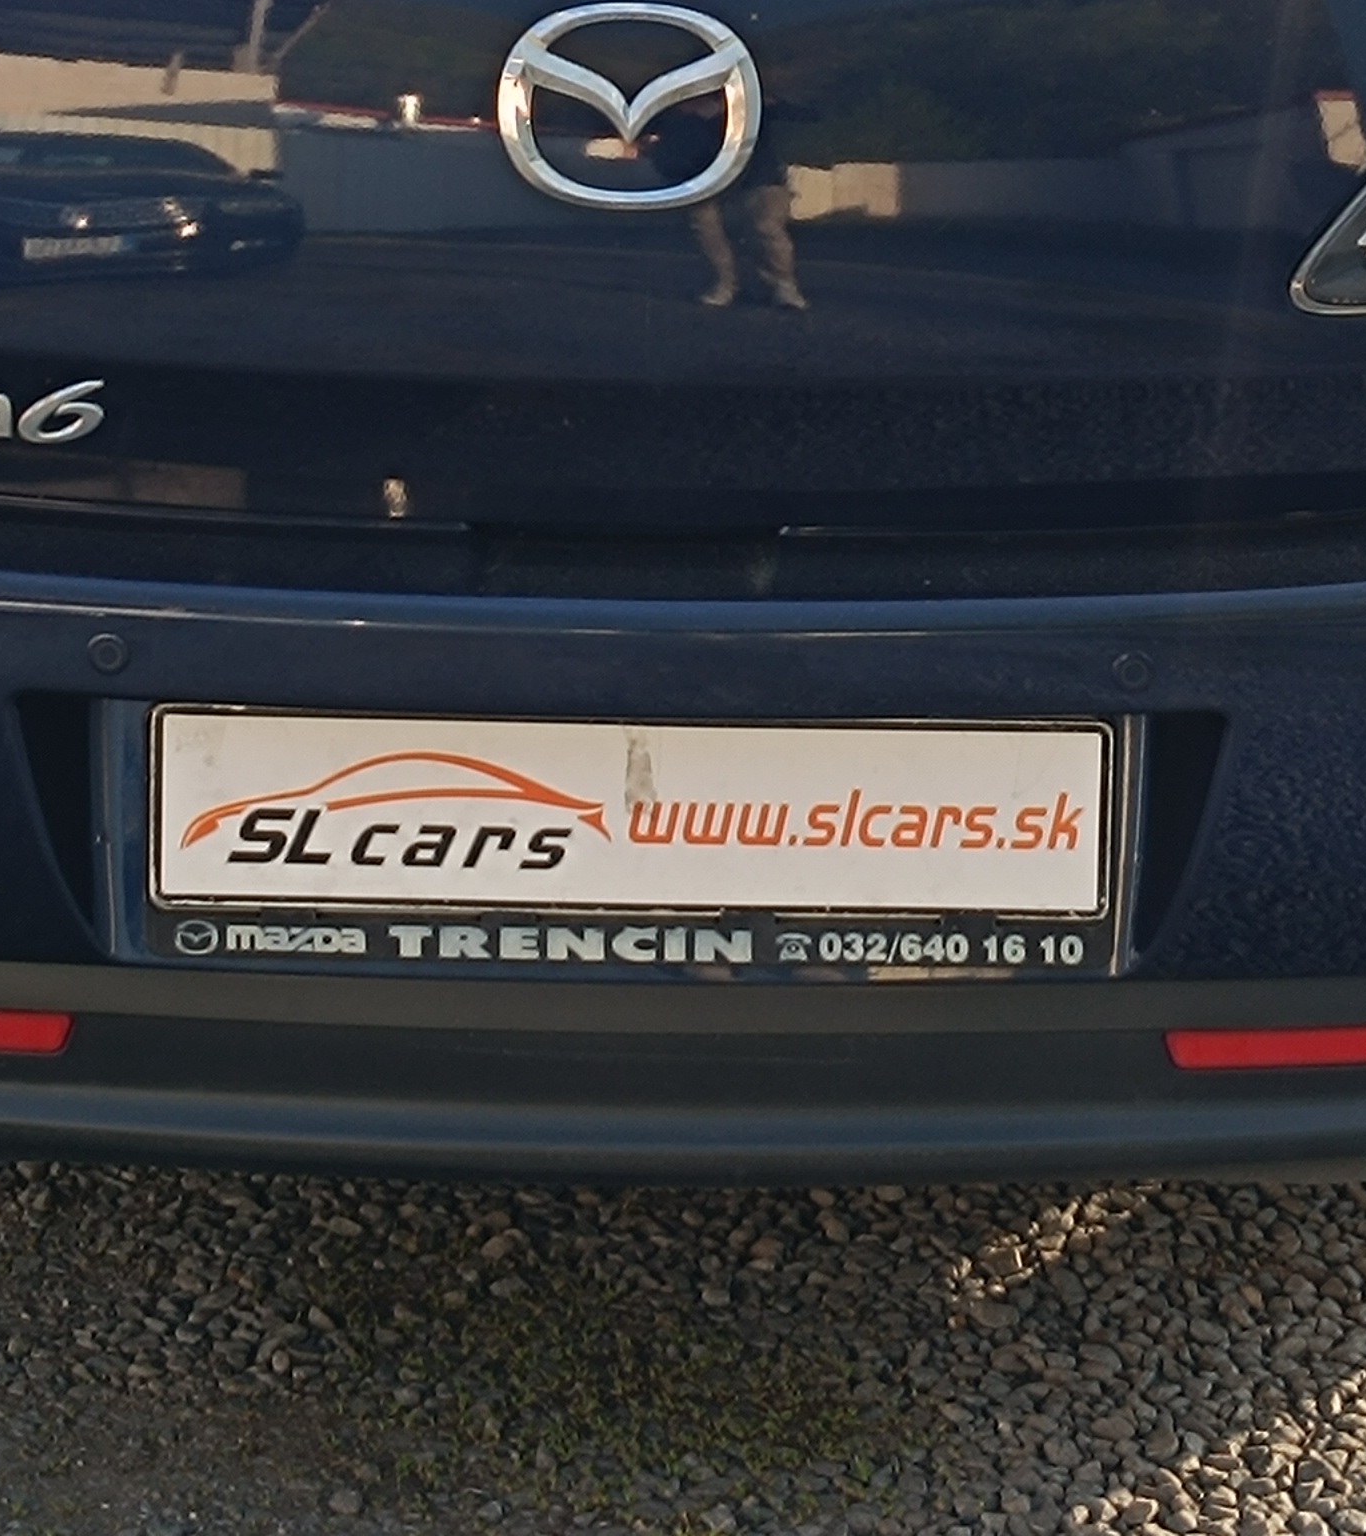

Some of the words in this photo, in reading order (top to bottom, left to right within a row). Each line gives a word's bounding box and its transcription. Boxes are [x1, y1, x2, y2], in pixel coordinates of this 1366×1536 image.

[628, 788, 1085, 851] www.slcars.sk
[818, 931, 970, 964] 032/640
[982, 934, 1027, 964] 16
[1040, 935, 1085, 965] 10
